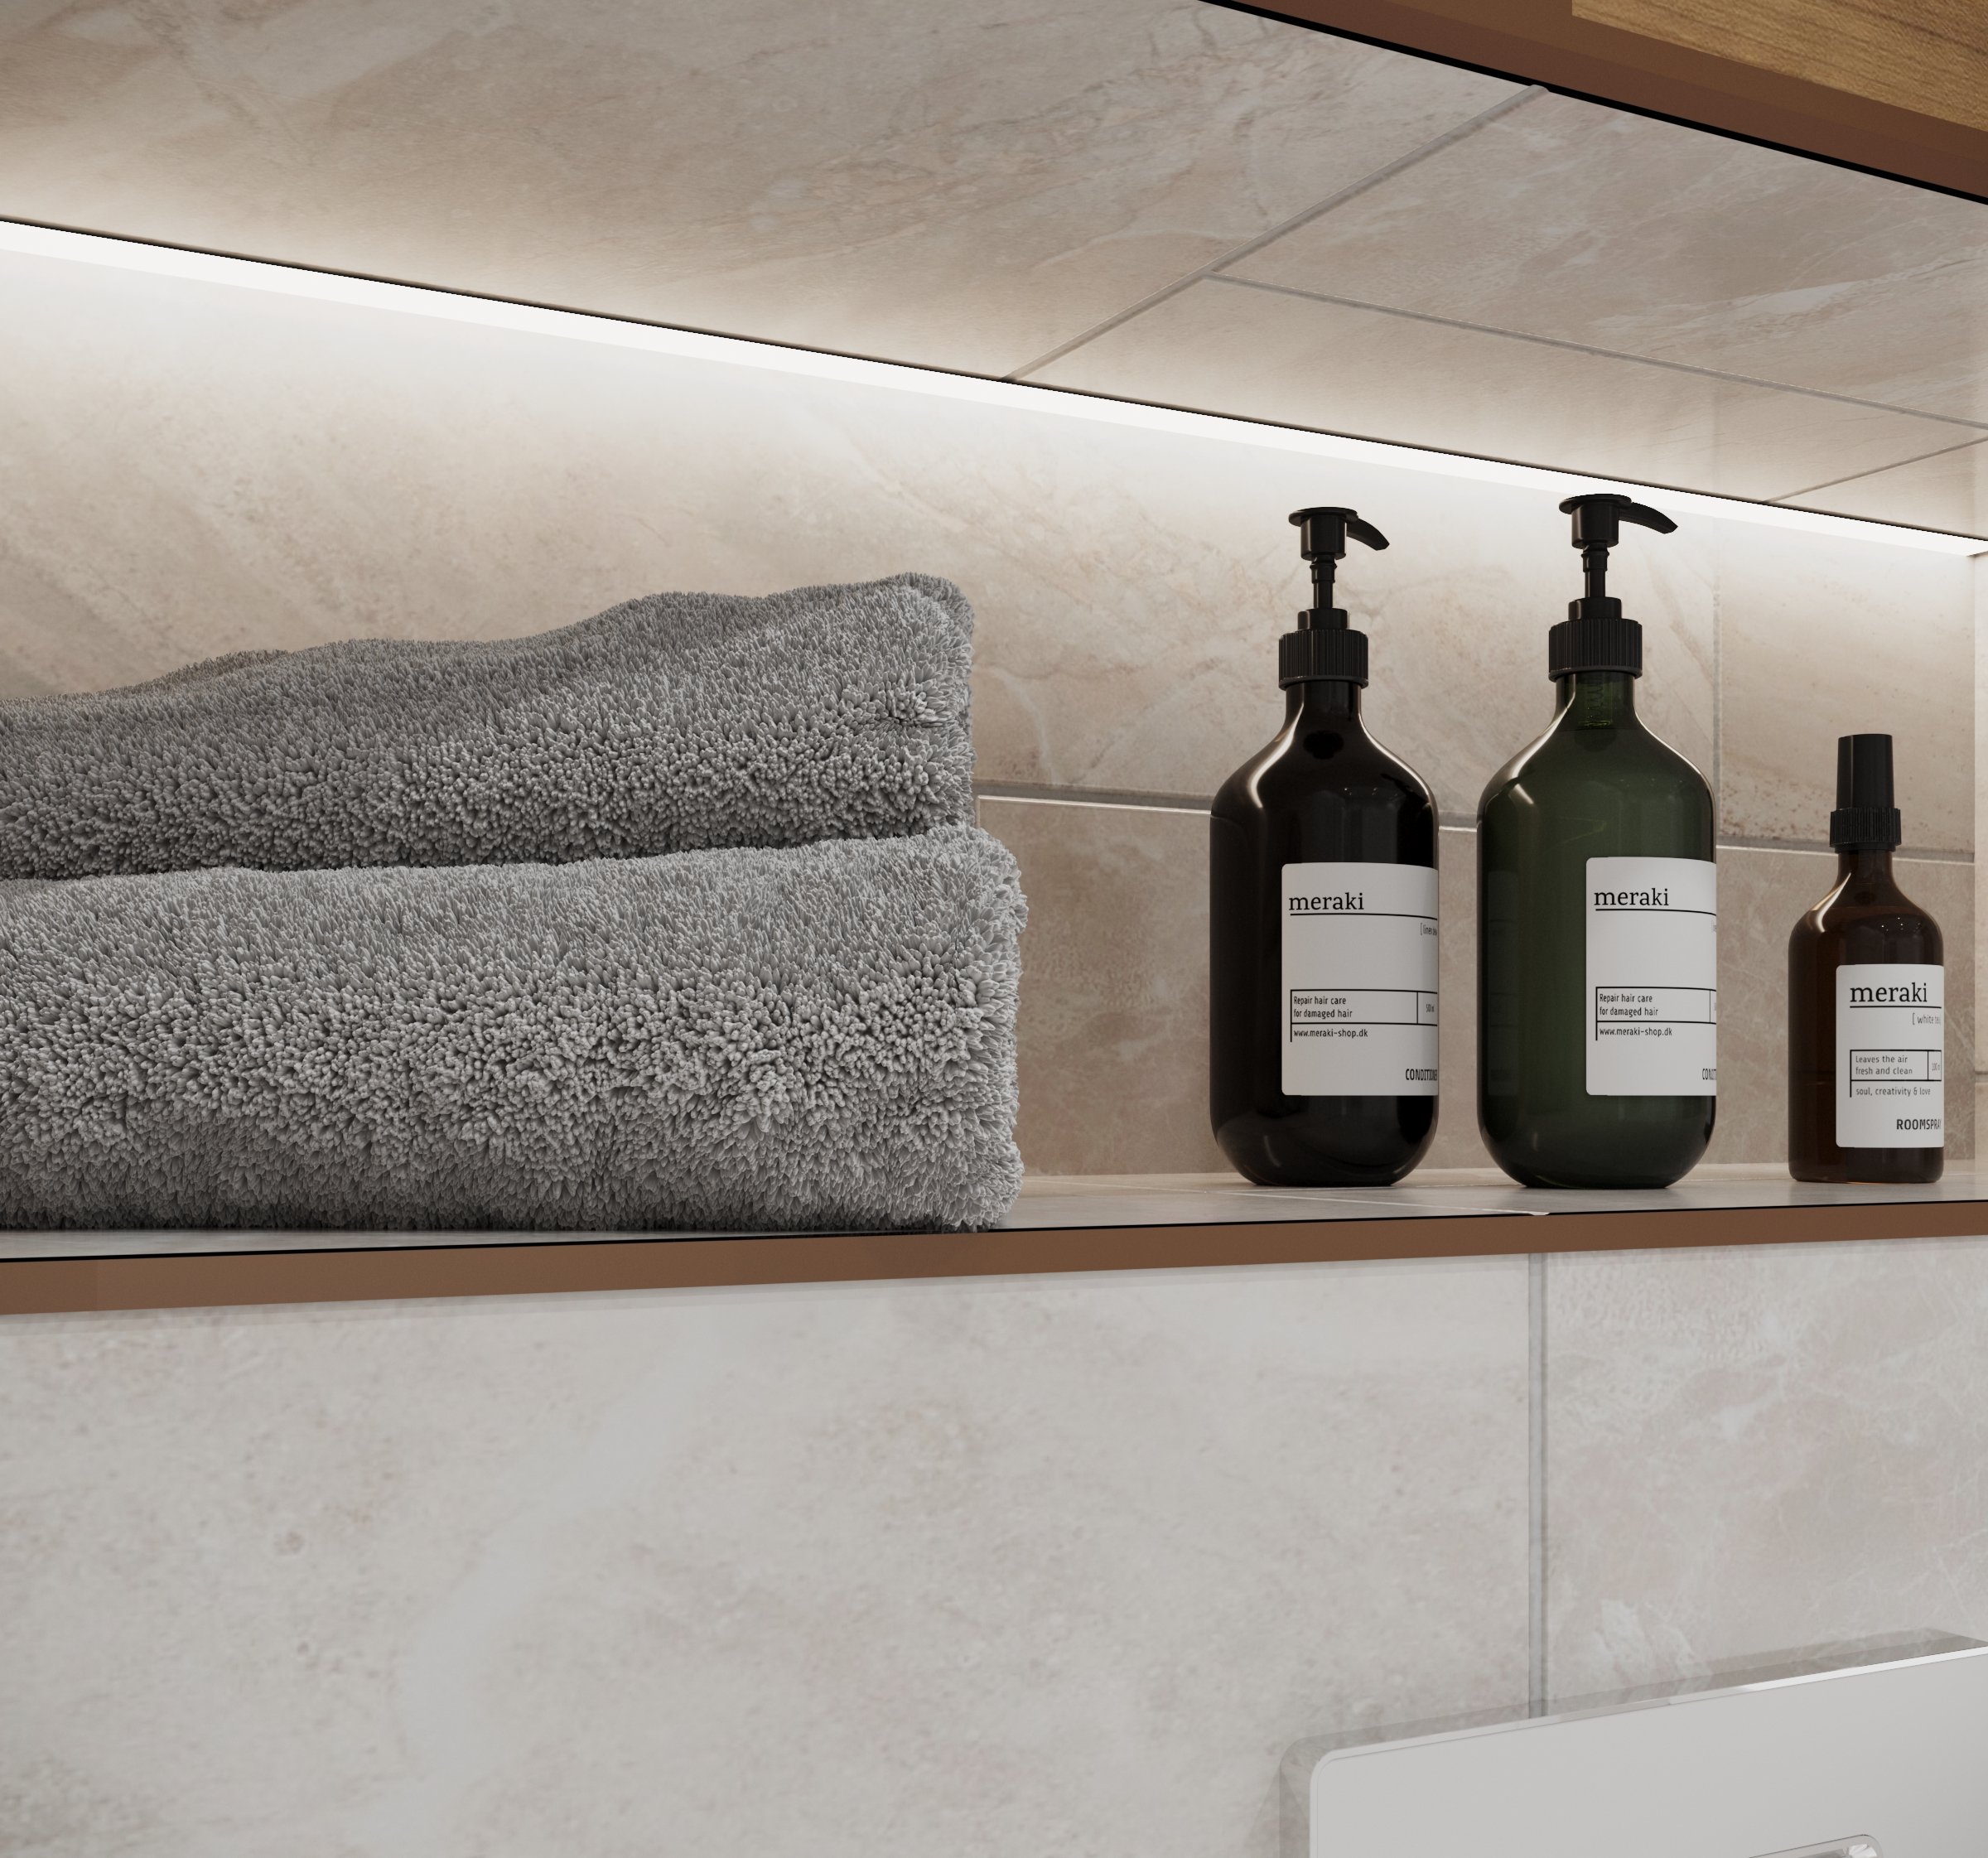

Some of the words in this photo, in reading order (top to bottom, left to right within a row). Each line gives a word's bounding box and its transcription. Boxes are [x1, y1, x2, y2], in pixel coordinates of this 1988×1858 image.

[1288, 892, 1364, 910] meraki
[1594, 888, 1669, 906] meraki
[1850, 982, 1928, 1002] meraki
[1294, 996, 1313, 1006] Repair
[1315, 996, 1328, 1005] hair
[1600, 993, 1619, 1003] Repair
[1621, 993, 1635, 1002] hair
[1294, 1008, 1302, 1017] for
[1304, 1009, 1335, 1019] damaged
[1338, 1009, 1353, 1017] hair
[1600, 1006, 1608, 1015] for
[1610, 1007, 1642, 1017] damaged
[1644, 1007, 1658, 1016] hair
[1294, 1029, 1368, 1039] www.meraki-shop.dk
[1600, 1027, 1672, 1037] www.meraki-shop.dk
[1856, 1087, 1872, 1096] soul,
[1875, 1087, 1911, 1097] creativity
[1919, 1087, 1931, 1095] love
